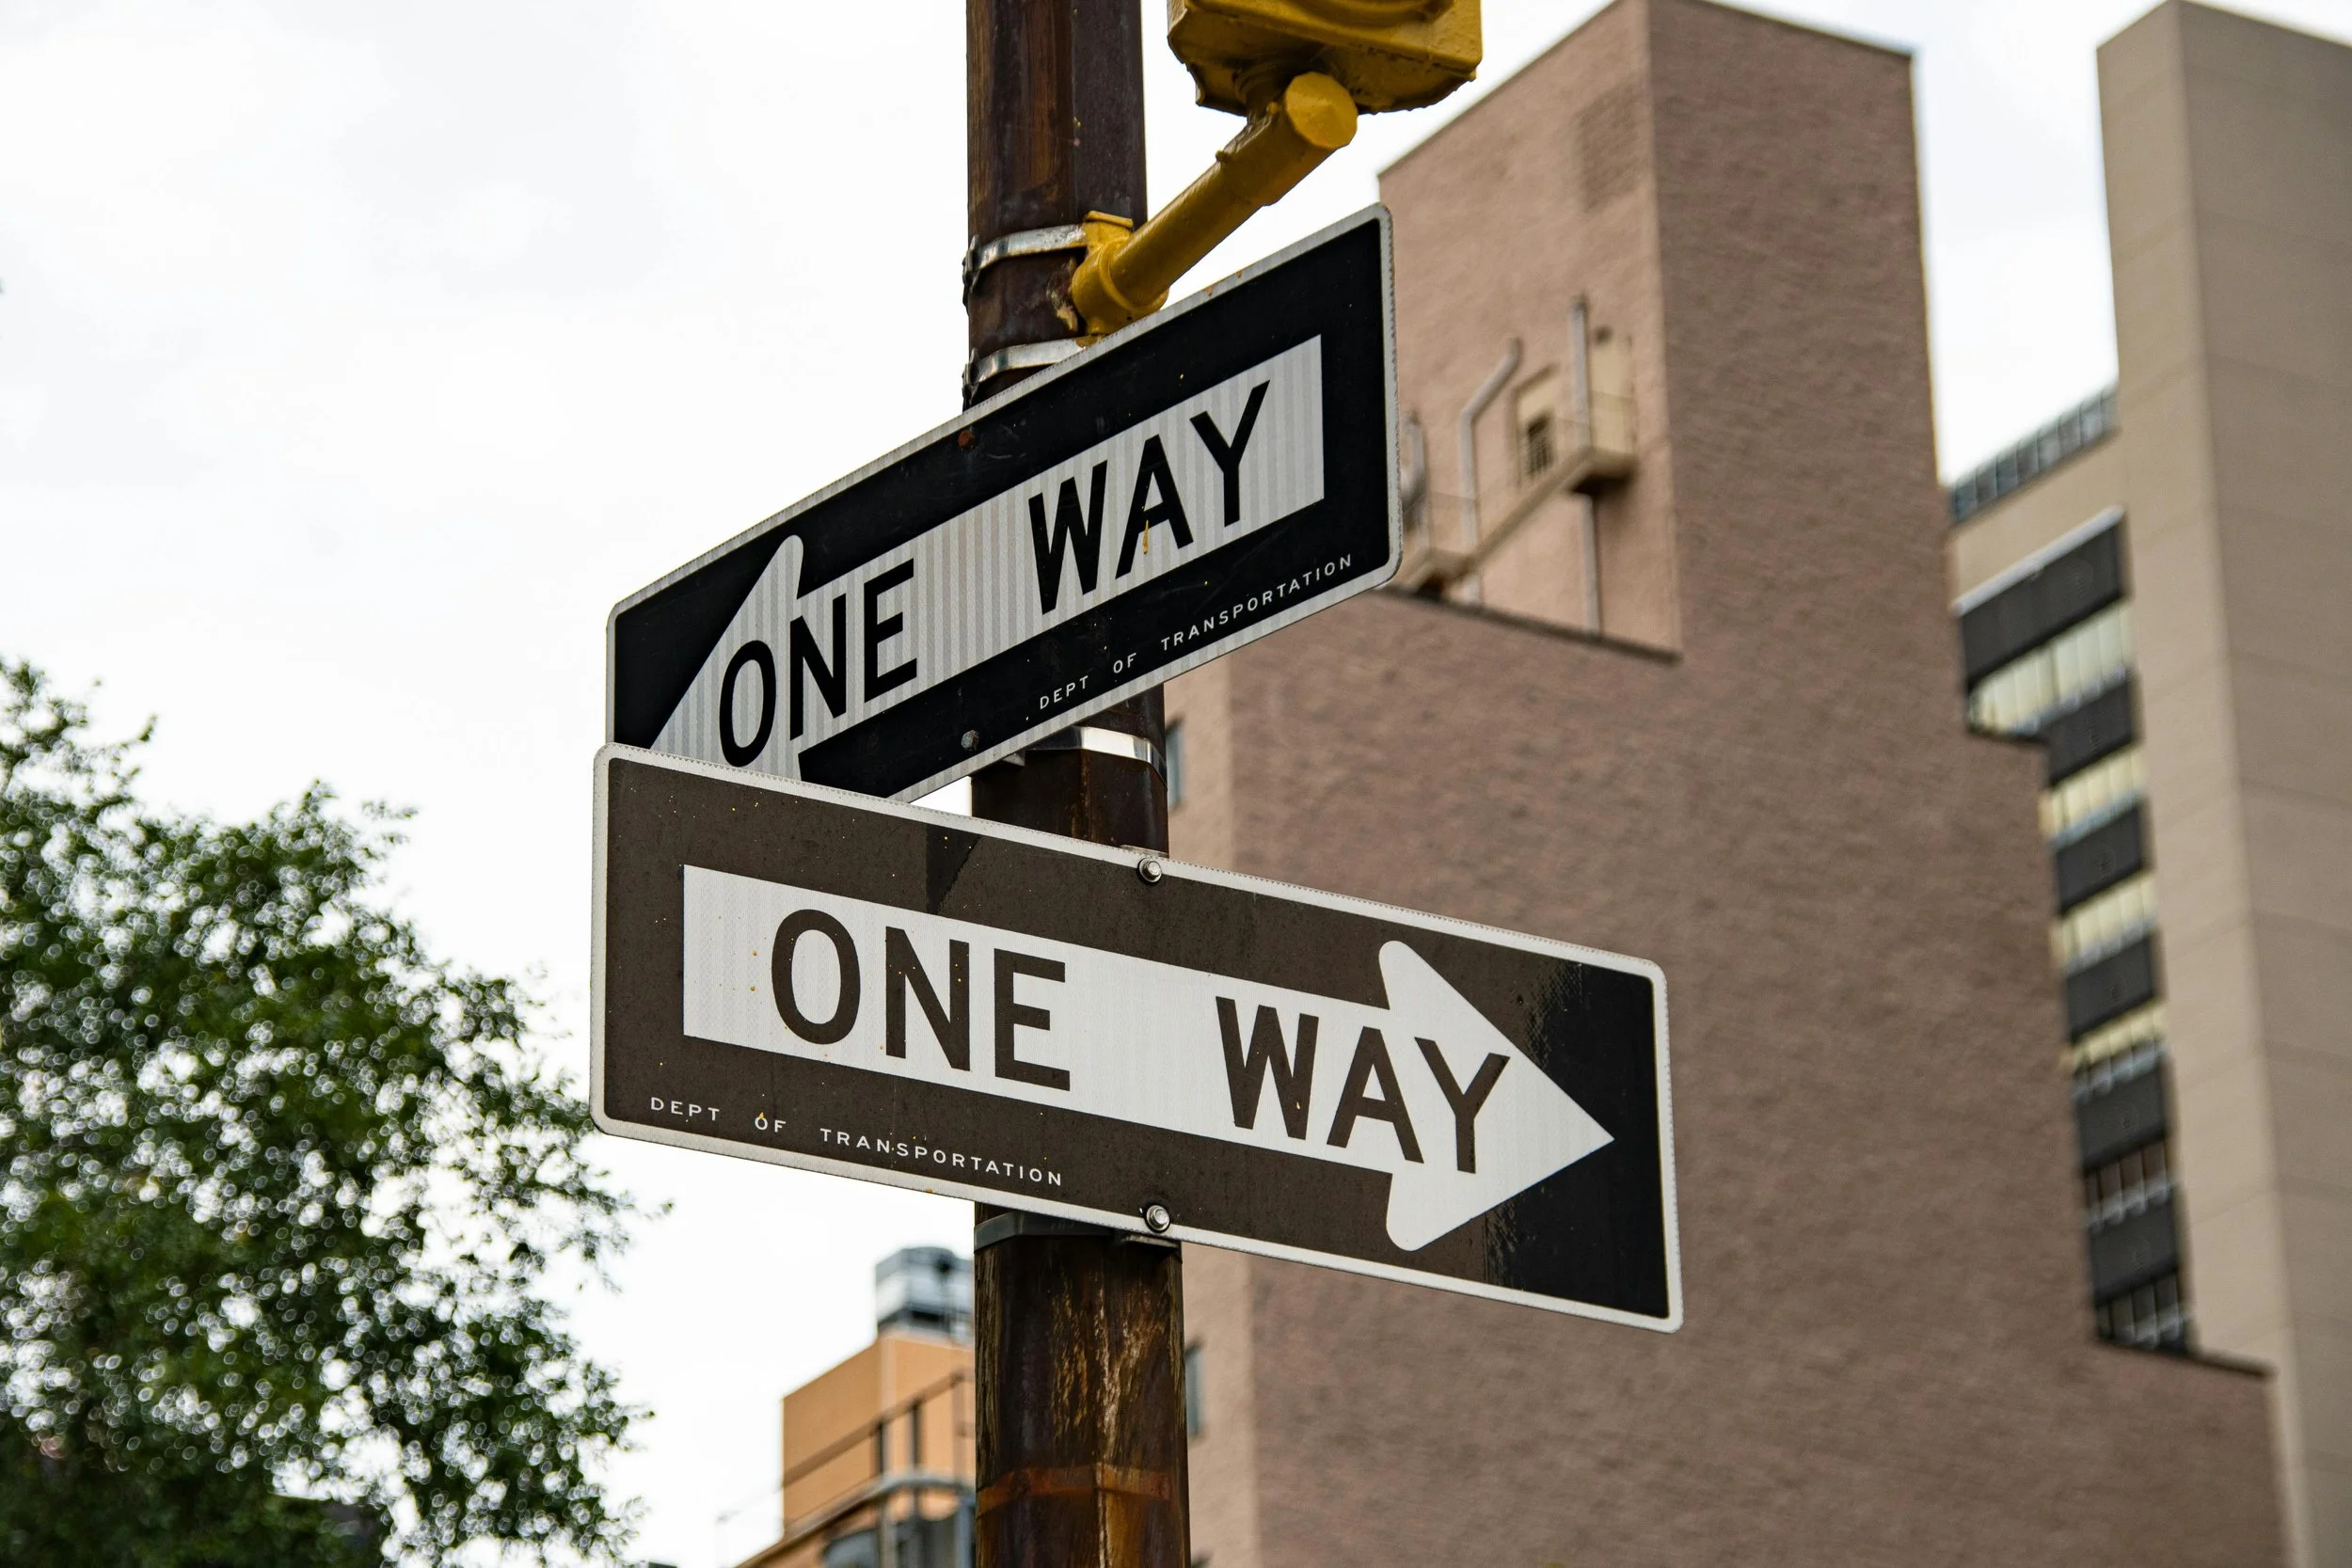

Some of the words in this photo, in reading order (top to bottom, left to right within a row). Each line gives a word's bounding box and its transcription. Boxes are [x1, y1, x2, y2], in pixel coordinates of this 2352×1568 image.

[720, 558, 917, 768] ONE
[1028, 379, 1271, 615] WAY
[1039, 674, 1089, 710] DEPT
[1112, 653, 1137, 675] OF
[1160, 553, 1353, 652] TRANSPORTATION
[650, 1096, 721, 1122] DEPT
[754, 1115, 787, 1134] OF
[818, 1127, 1062, 1187] TRANSPORTATION
[771, 909, 1071, 1092] ONE
[1216, 996, 1511, 1175] WAY
